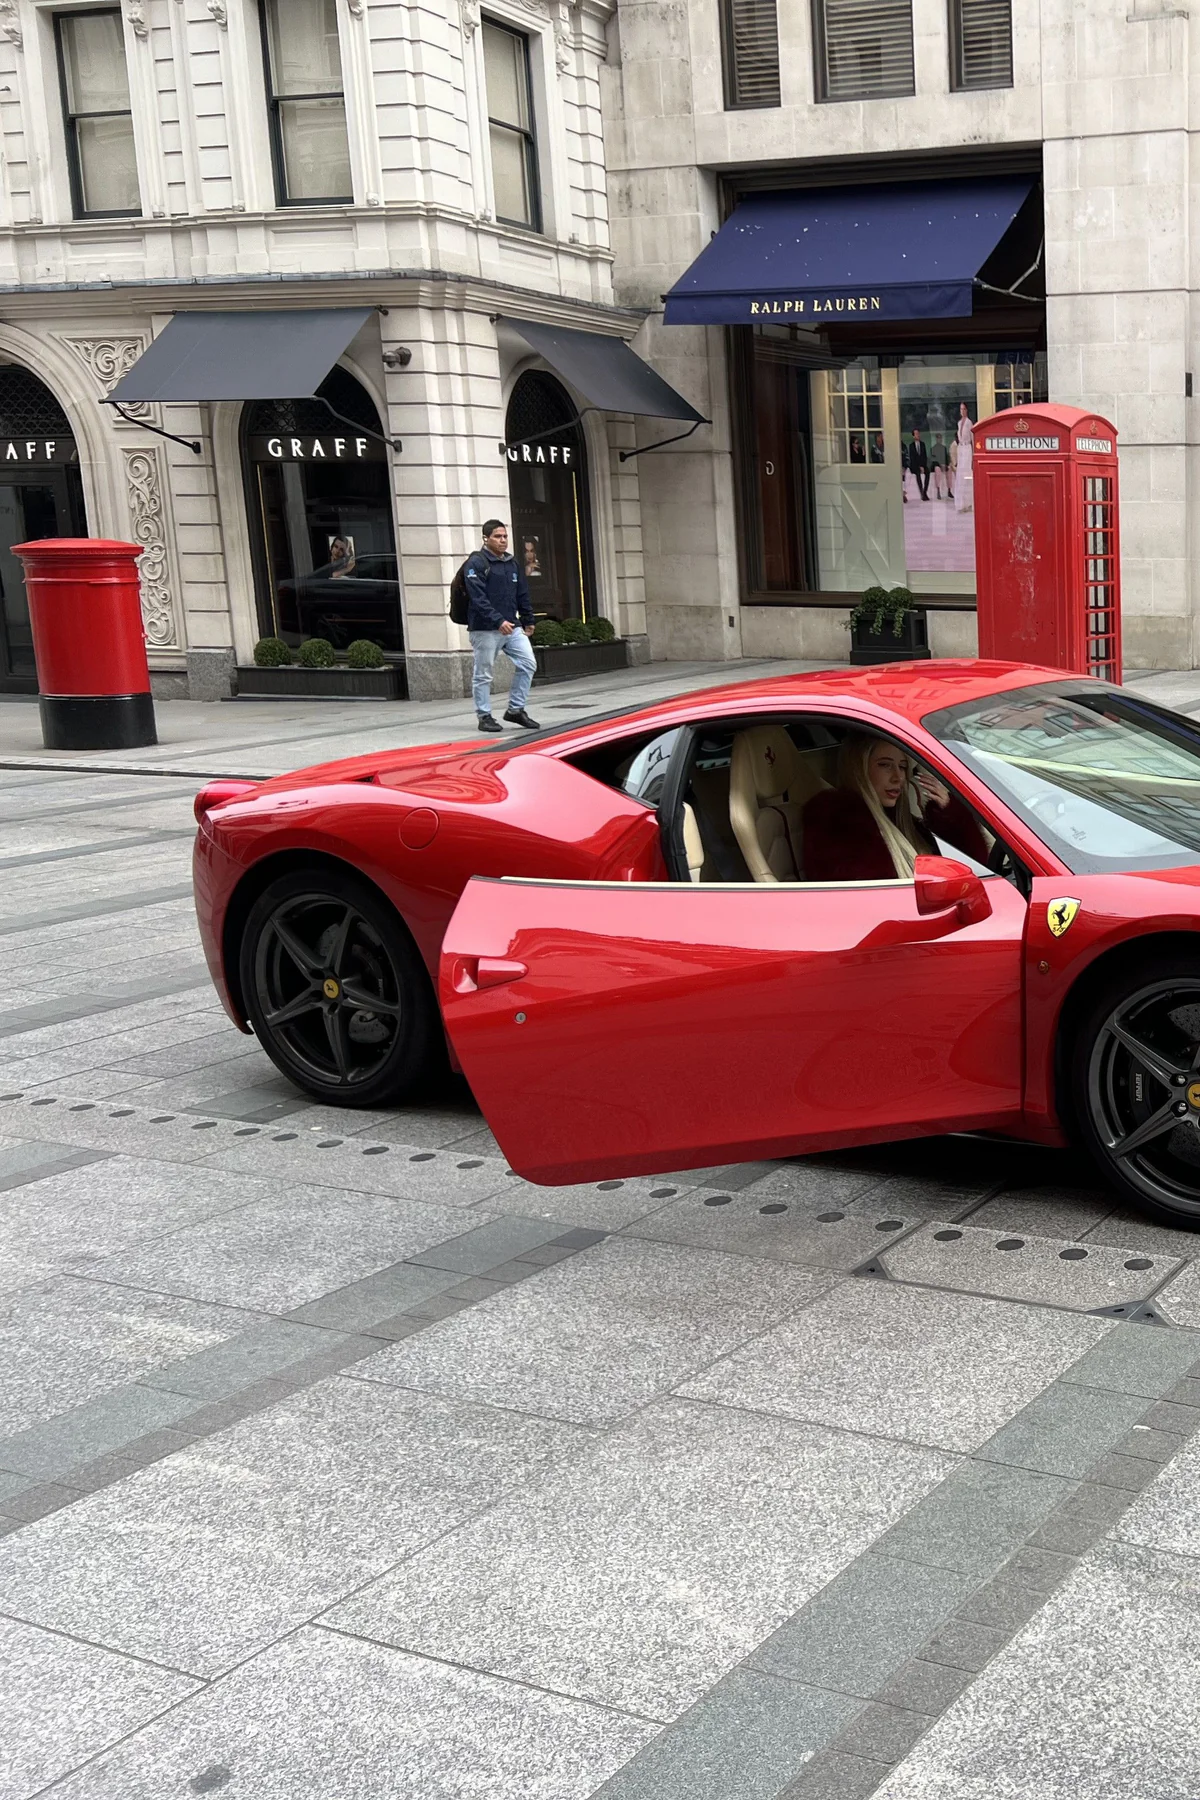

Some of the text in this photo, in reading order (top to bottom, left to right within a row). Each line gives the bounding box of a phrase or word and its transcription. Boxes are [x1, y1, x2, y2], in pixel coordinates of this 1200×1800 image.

[750, 296, 880, 314] RALPH LAUREN
[267, 438, 368, 457] GRAFF
[988, 437, 1057, 449] TELEPHONE
[1077, 438, 1110, 452] TELEPHONE
[507, 444, 571, 464] GRAFF
